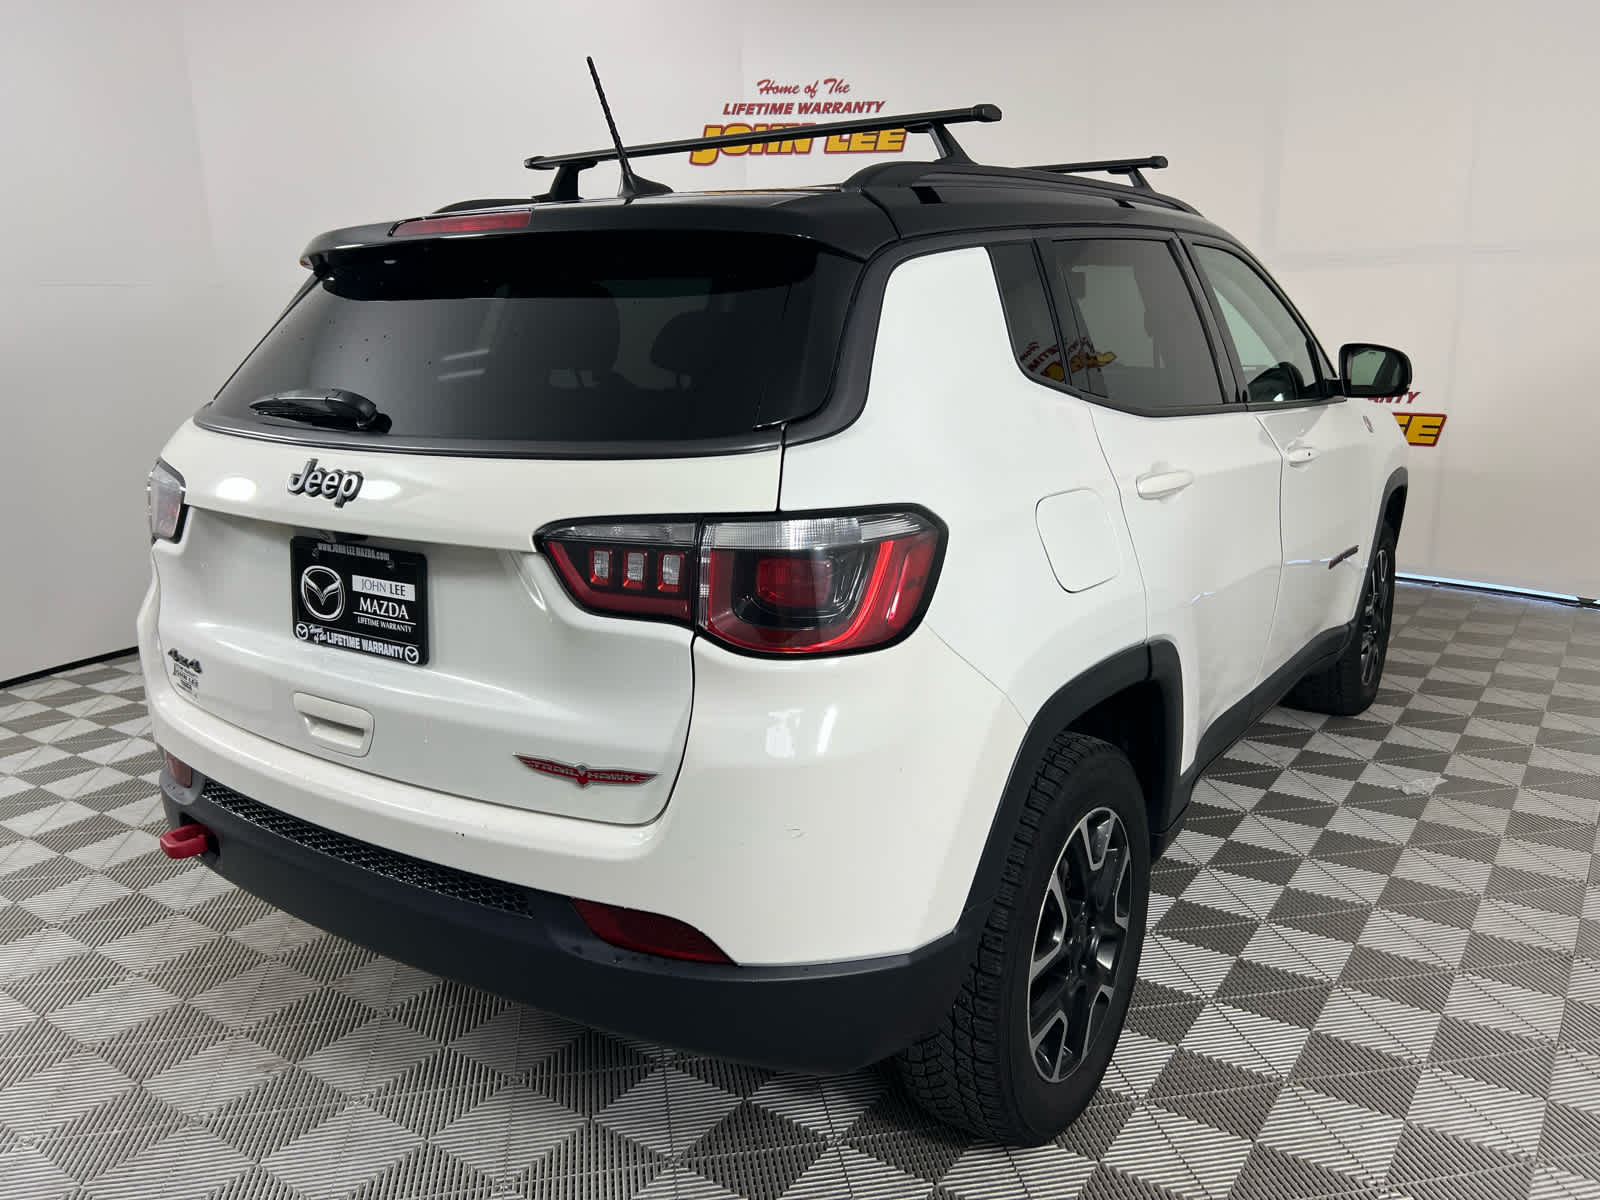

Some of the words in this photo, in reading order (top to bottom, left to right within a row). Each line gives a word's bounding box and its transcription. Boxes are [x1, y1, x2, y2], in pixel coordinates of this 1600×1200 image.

[757, 79, 800, 95] Home
[804, 80, 819, 97] of
[824, 78, 850, 94] The
[723, 103, 794, 115] LIFETIME
[798, 101, 886, 114] WARRANTY
[824, 127, 907, 154] LEE
[288, 458, 364, 508] Jeep
[361, 578, 387, 593] JOHN
[389, 583, 406, 597] LEE
[359, 597, 409, 620] MAZDA
[357, 616, 380, 628] LIFETIME
[380, 620, 412, 633] WARRANTY
[326, 631, 361, 650] LIFETIME
[361, 638, 404, 659] WARRANTY
